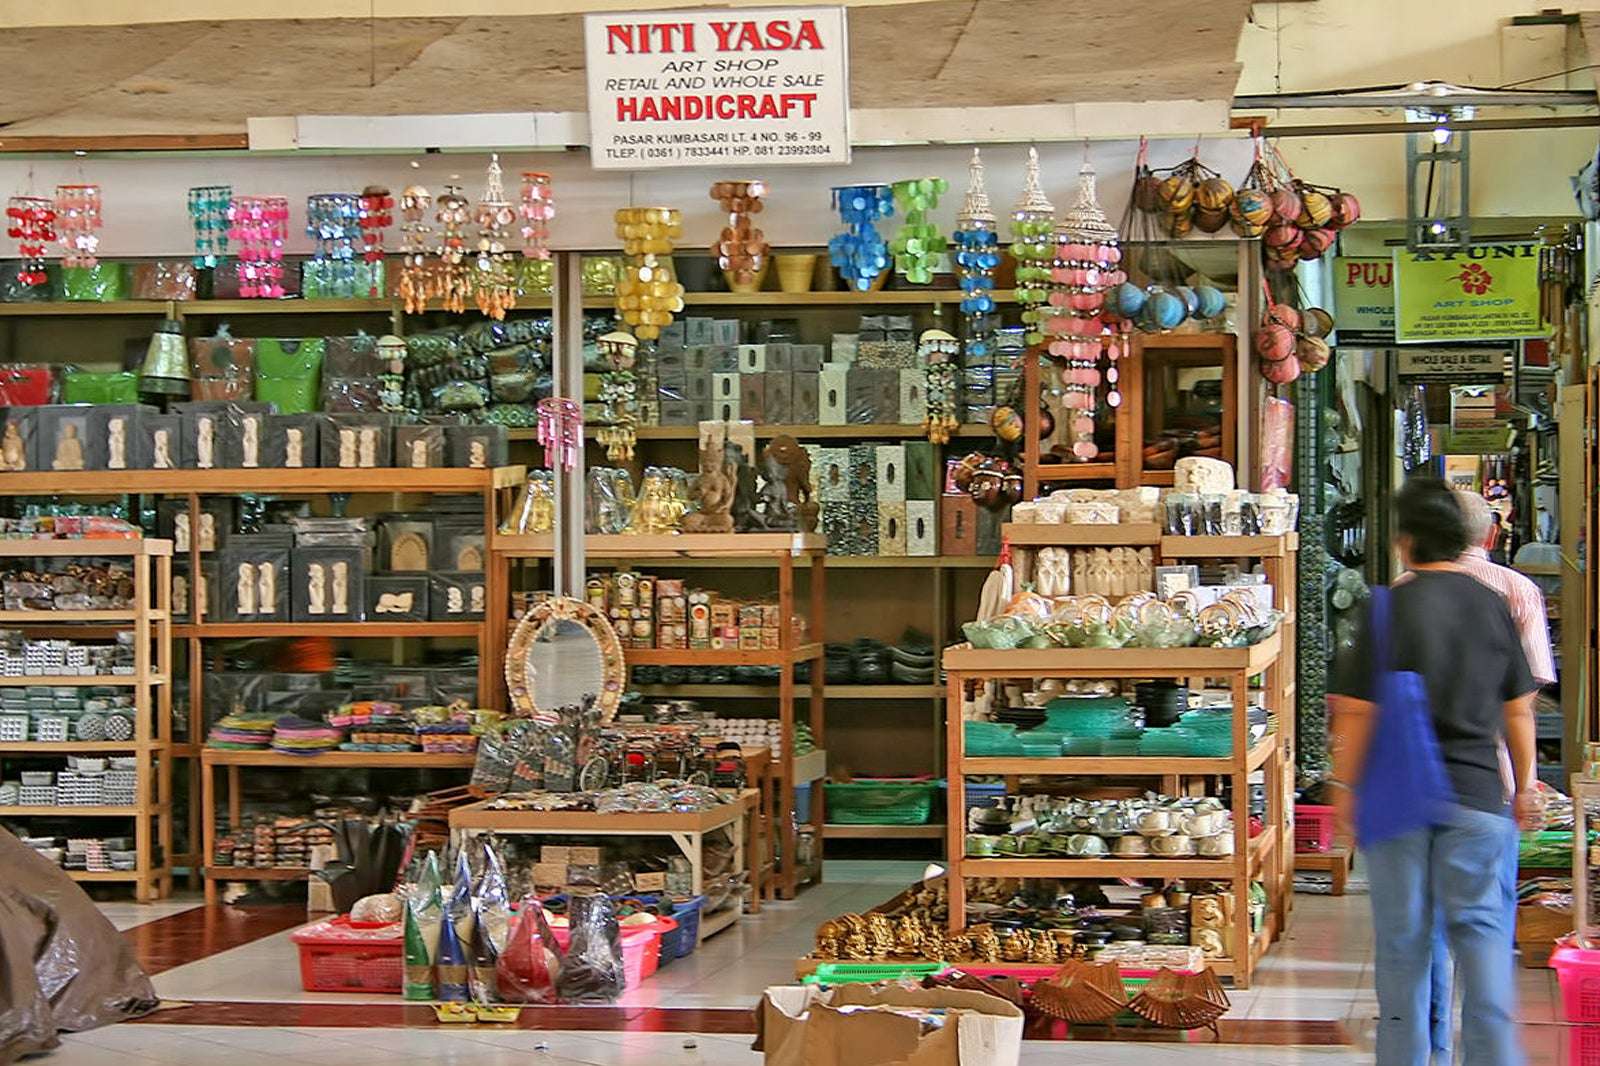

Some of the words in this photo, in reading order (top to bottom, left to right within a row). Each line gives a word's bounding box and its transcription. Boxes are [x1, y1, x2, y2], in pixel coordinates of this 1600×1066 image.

[606, 23, 695, 54] NITI
[708, 20, 825, 51] YASA
[662, 60, 707, 73] ART
[713, 58, 779, 72] SHOP
[605, 78, 660, 91] RETAIL
[664, 76, 706, 90] AND
[712, 75, 777, 89] WHOLE
[783, 74, 825, 88] SALE
[616, 93, 817, 122] HANDICRAFT
[613, 134, 653, 145] PASAR
[656, 132, 729, 144] KUMBASARI
[750, 132, 757, 141] 4
[1433, 299, 1465, 309] ART
[1470, 298, 1515, 308] SHOP
